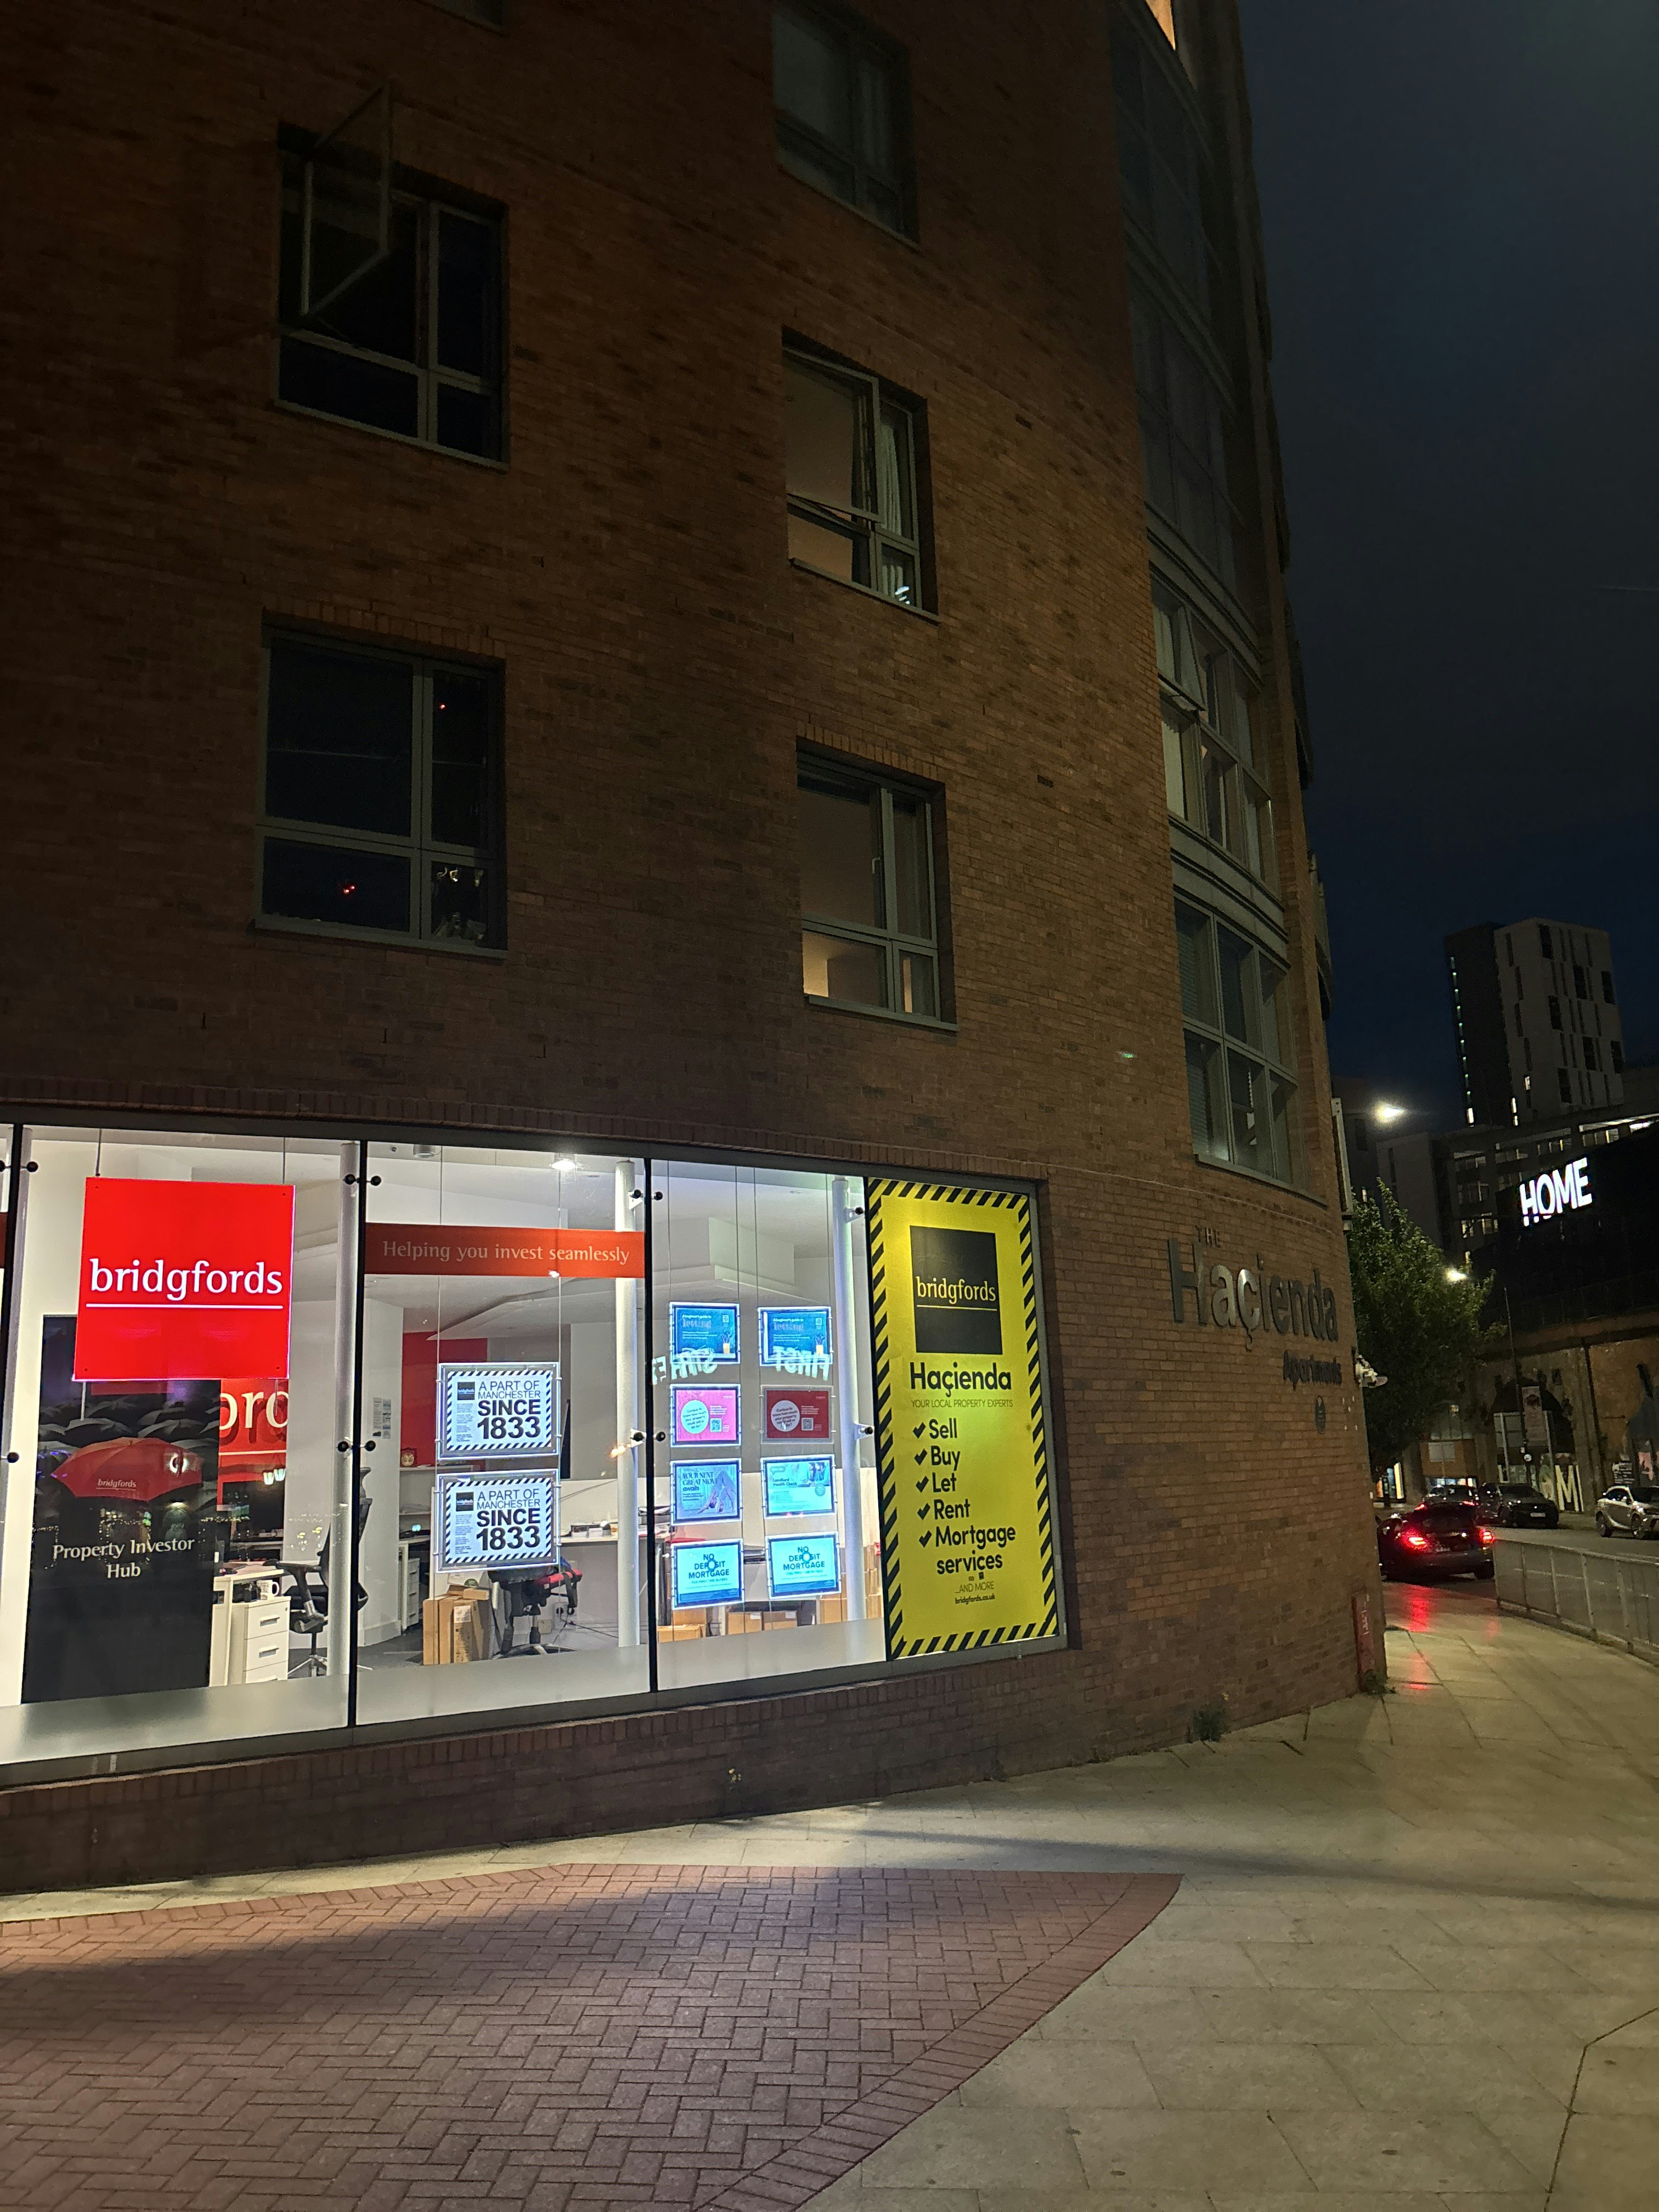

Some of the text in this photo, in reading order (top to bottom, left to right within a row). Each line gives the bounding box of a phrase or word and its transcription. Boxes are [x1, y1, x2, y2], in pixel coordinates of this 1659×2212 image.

[1519, 1157, 1593, 1226] HOME
[383, 1240, 630, 1265] Helping you invest seamlessly
[89, 1258, 283, 1301] bridgfords
[916, 1276, 996, 1305] bridgfords
[479, 1380, 540, 1391] A PART OF
[910, 1361, 1012, 1398] Haçienda
[478, 1390, 540, 1399] MANCHESTER
[911, 1398, 1013, 1408] YOUR LOCAL PROPERTY EXPERTS
[477, 1399, 541, 1416] SINCE
[477, 1416, 541, 1440] 1833
[929, 1418, 958, 1440] Sell
[930, 1445, 961, 1471] Buy
[98, 1479, 137, 1488] bridgfords
[932, 1472, 957, 1493] Let
[477, 1488, 540, 1501] A PART OF
[477, 1498, 540, 1510] MANCHESTER
[476, 1508, 541, 1527] SINCE
[934, 1498, 970, 1520] Rent
[476, 1525, 541, 1551] 1833
[935, 1524, 1016, 1550] Mortgage
[53, 1538, 195, 1561] Property Investor
[788, 1553, 821, 1562] DEPOSIT
[106, 1562, 142, 1578] Hub
[694, 1560, 725, 1570] DEPOSIT
[783, 1561, 825, 1570] MORTGAGE
[936, 1550, 1003, 1575] services
[689, 1568, 730, 1579] MORTGAGE
[975, 1581, 995, 1591] MORE
